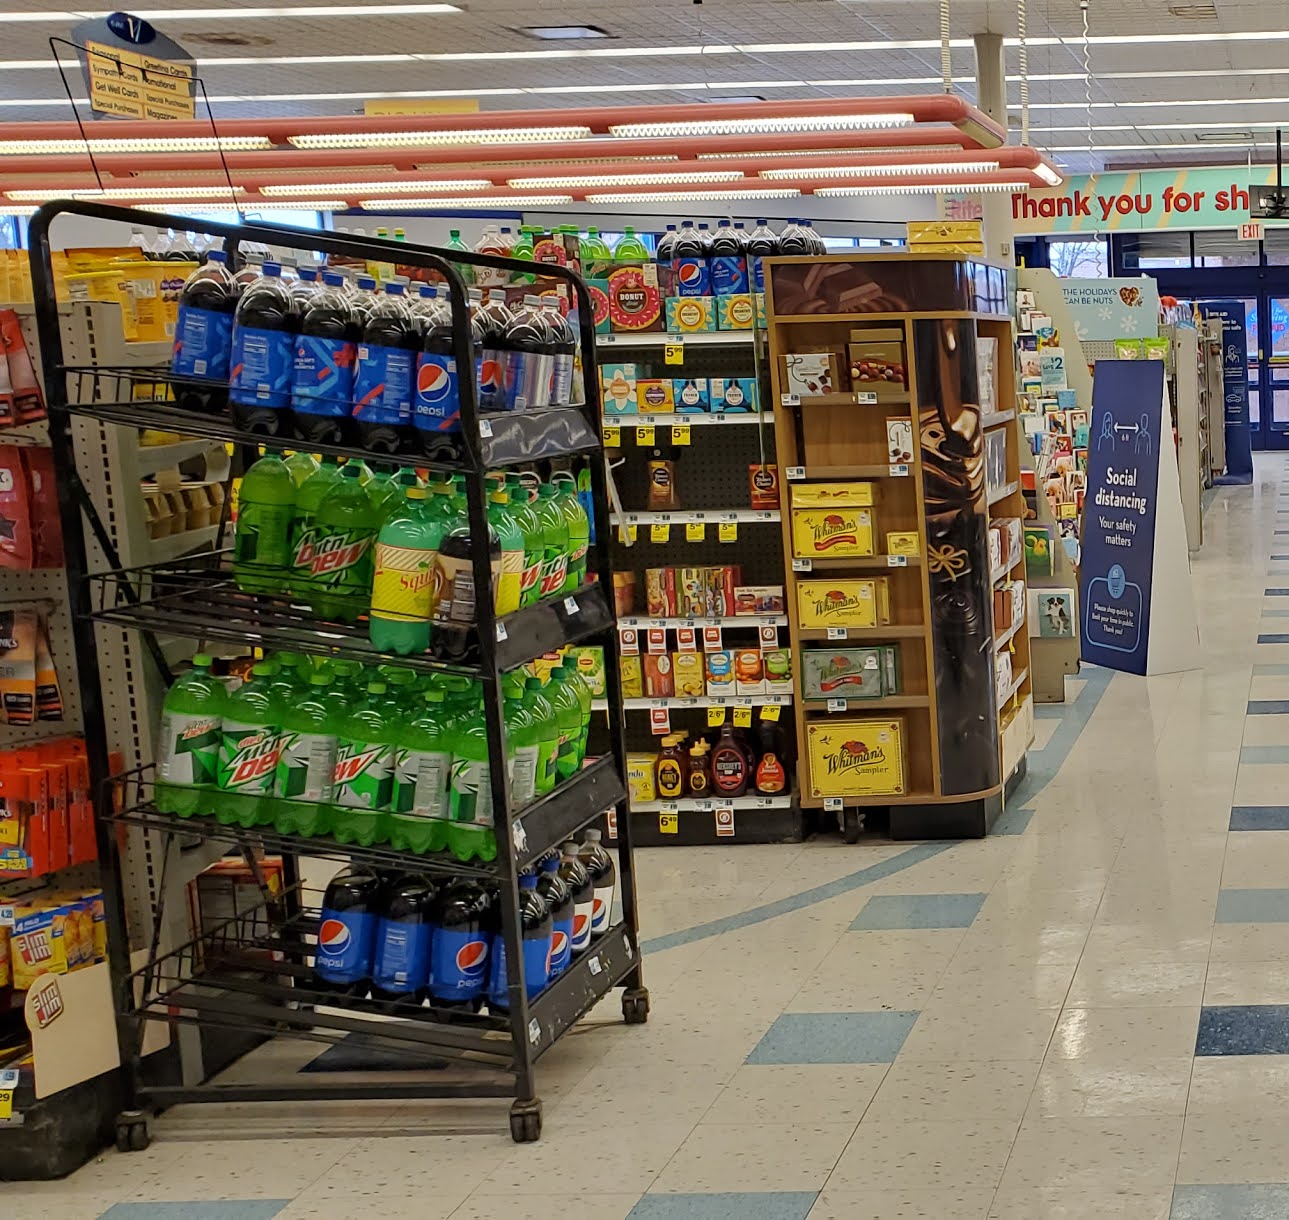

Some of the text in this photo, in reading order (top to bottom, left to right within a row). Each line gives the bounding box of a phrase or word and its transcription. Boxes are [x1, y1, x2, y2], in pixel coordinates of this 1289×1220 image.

[95, 81, 140, 99] Get Well Cards
[1011, 190, 1092, 219] Thank
[1098, 193, 1152, 221] you
[1162, 186, 1205, 213] for
[1242, 224, 1260, 239] EXIT
[619, 292, 644, 302] DONUT
[1062, 288, 1117, 296] THE HOLIDAYS
[1081, 297, 1091, 305] BE
[1093, 297, 1113, 305] NUTS
[1106, 467, 1137, 487] Social
[1095, 491, 1147, 515] distancing
[1099, 516, 1137, 535] Your safety
[1105, 534, 1132, 548] matters
[812, 595, 860, 617] Whitman's
[823, 745, 886, 776] Whitman's
[855, 765, 888, 776] Sampler
[317, 956, 344, 970] pepsi
